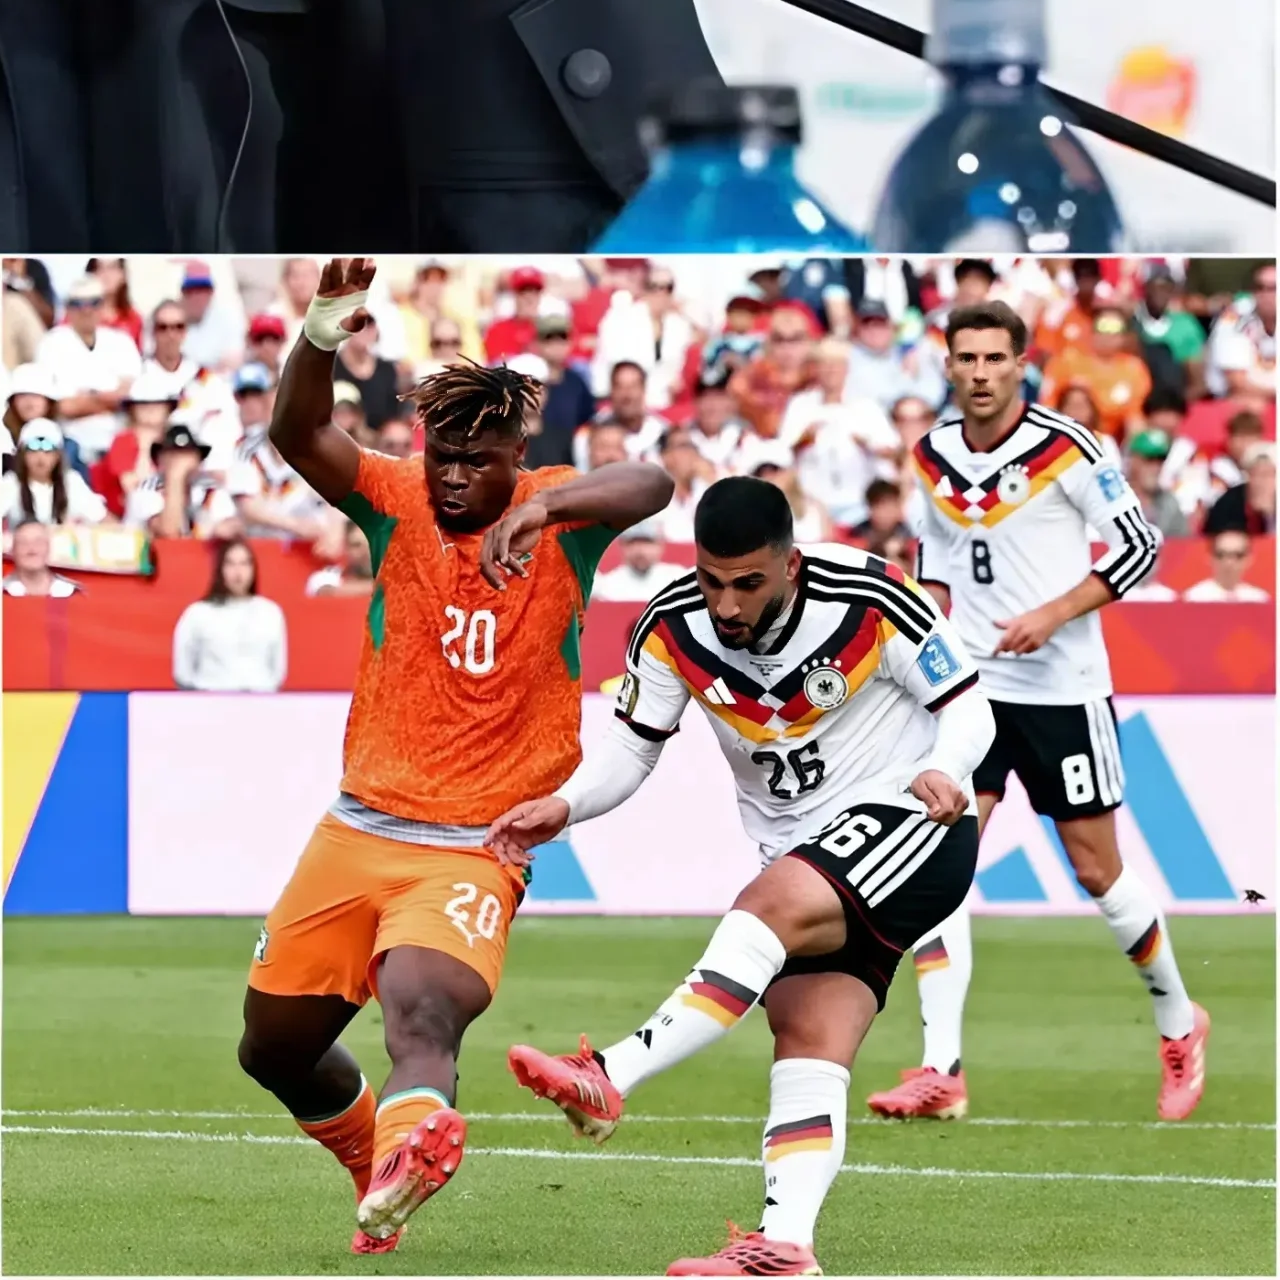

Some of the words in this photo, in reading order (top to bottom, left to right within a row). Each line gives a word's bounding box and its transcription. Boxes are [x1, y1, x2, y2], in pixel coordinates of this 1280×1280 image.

[972, 540, 994, 584] 8
[441, 605, 497, 675] 20
[751, 743, 826, 799] 26
[1061, 754, 1096, 805] 8
[445, 883, 502, 940] 20
